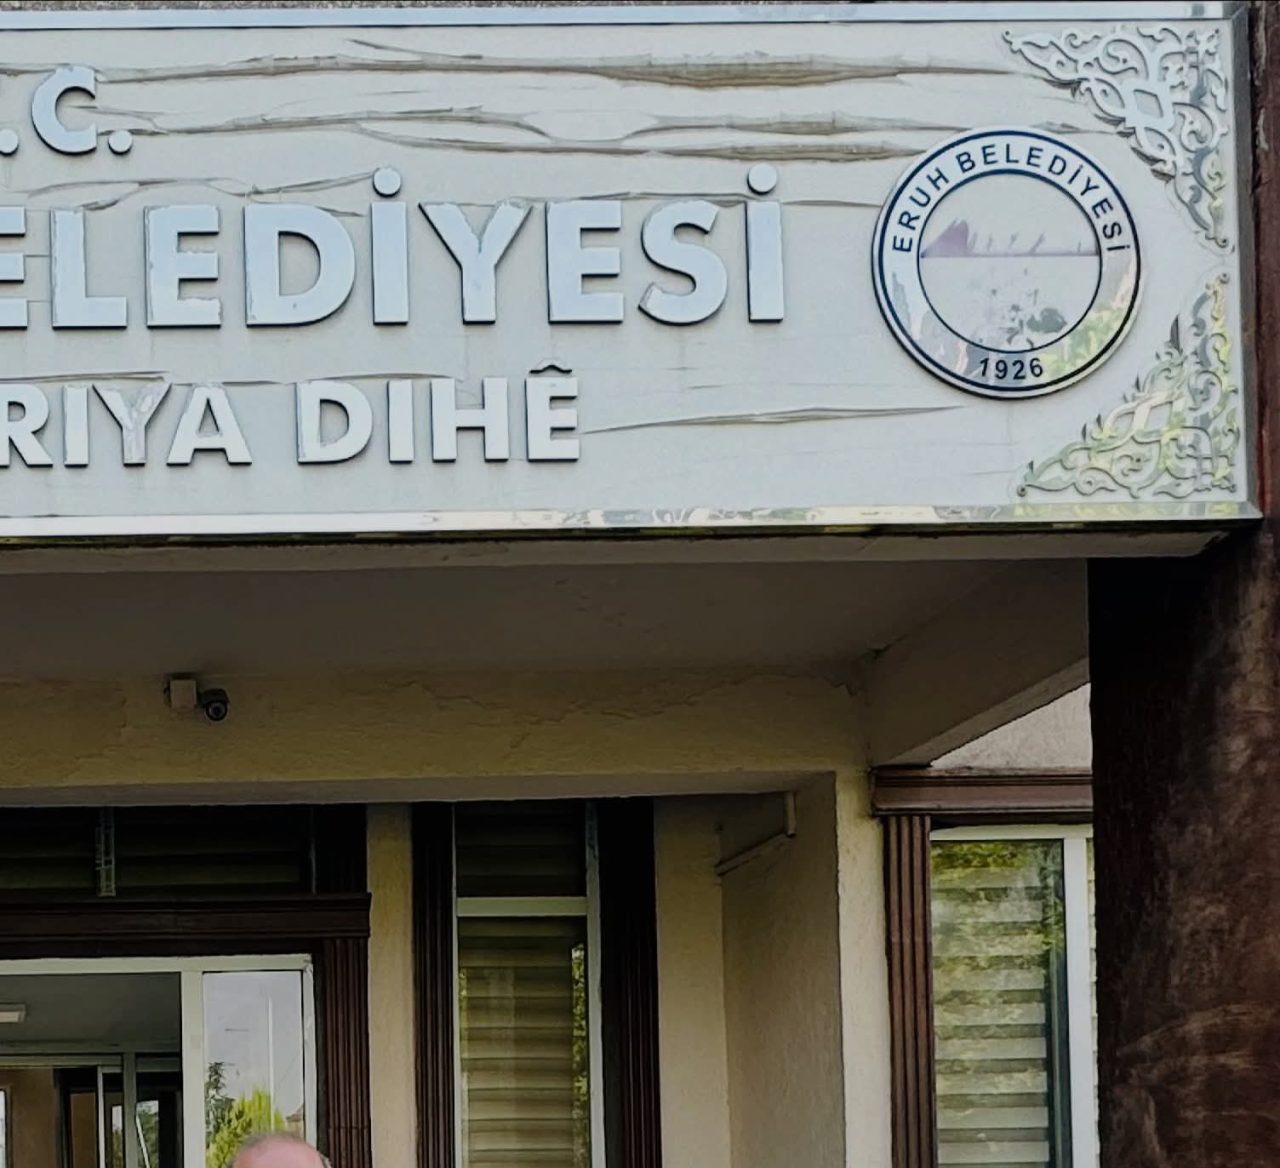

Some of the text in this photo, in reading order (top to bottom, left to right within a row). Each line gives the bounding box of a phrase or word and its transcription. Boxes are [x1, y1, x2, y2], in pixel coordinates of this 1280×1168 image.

[893, 143, 1131, 253] ERUH BELEDİYESİ
[295, 364, 582, 467] DIHÊ
[979, 357, 1044, 380] 1926
